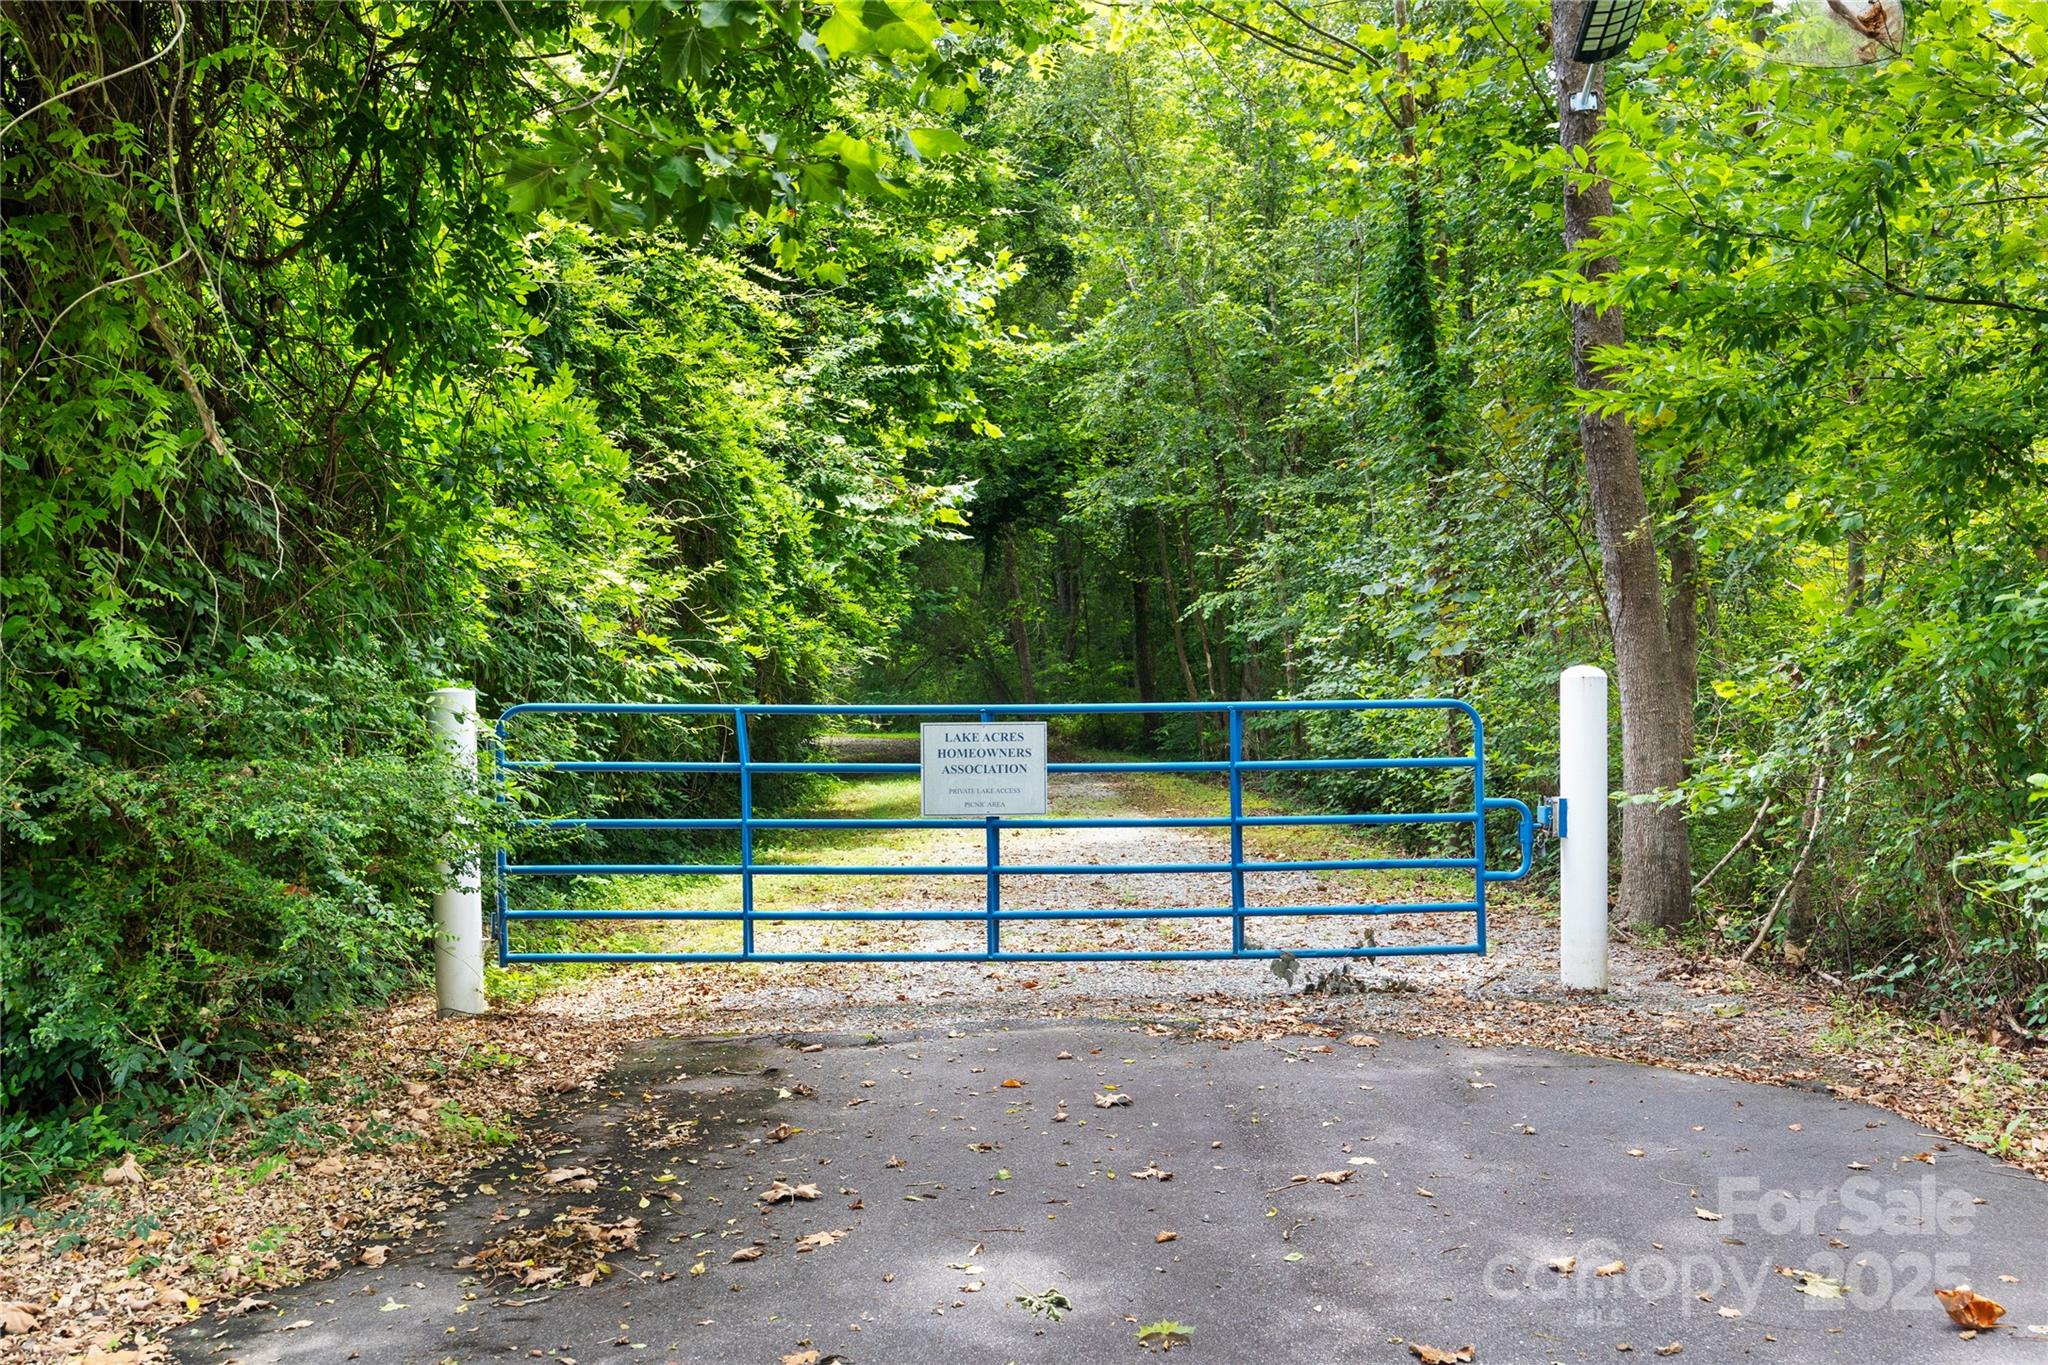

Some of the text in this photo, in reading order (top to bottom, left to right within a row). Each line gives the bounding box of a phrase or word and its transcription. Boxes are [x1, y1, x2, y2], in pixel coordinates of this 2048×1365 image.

[945, 732, 1025, 742] LAKE ACRES
[938, 748, 1032, 758] HOMEOWNERS
[942, 764, 1027, 774] ASSOCIATION
